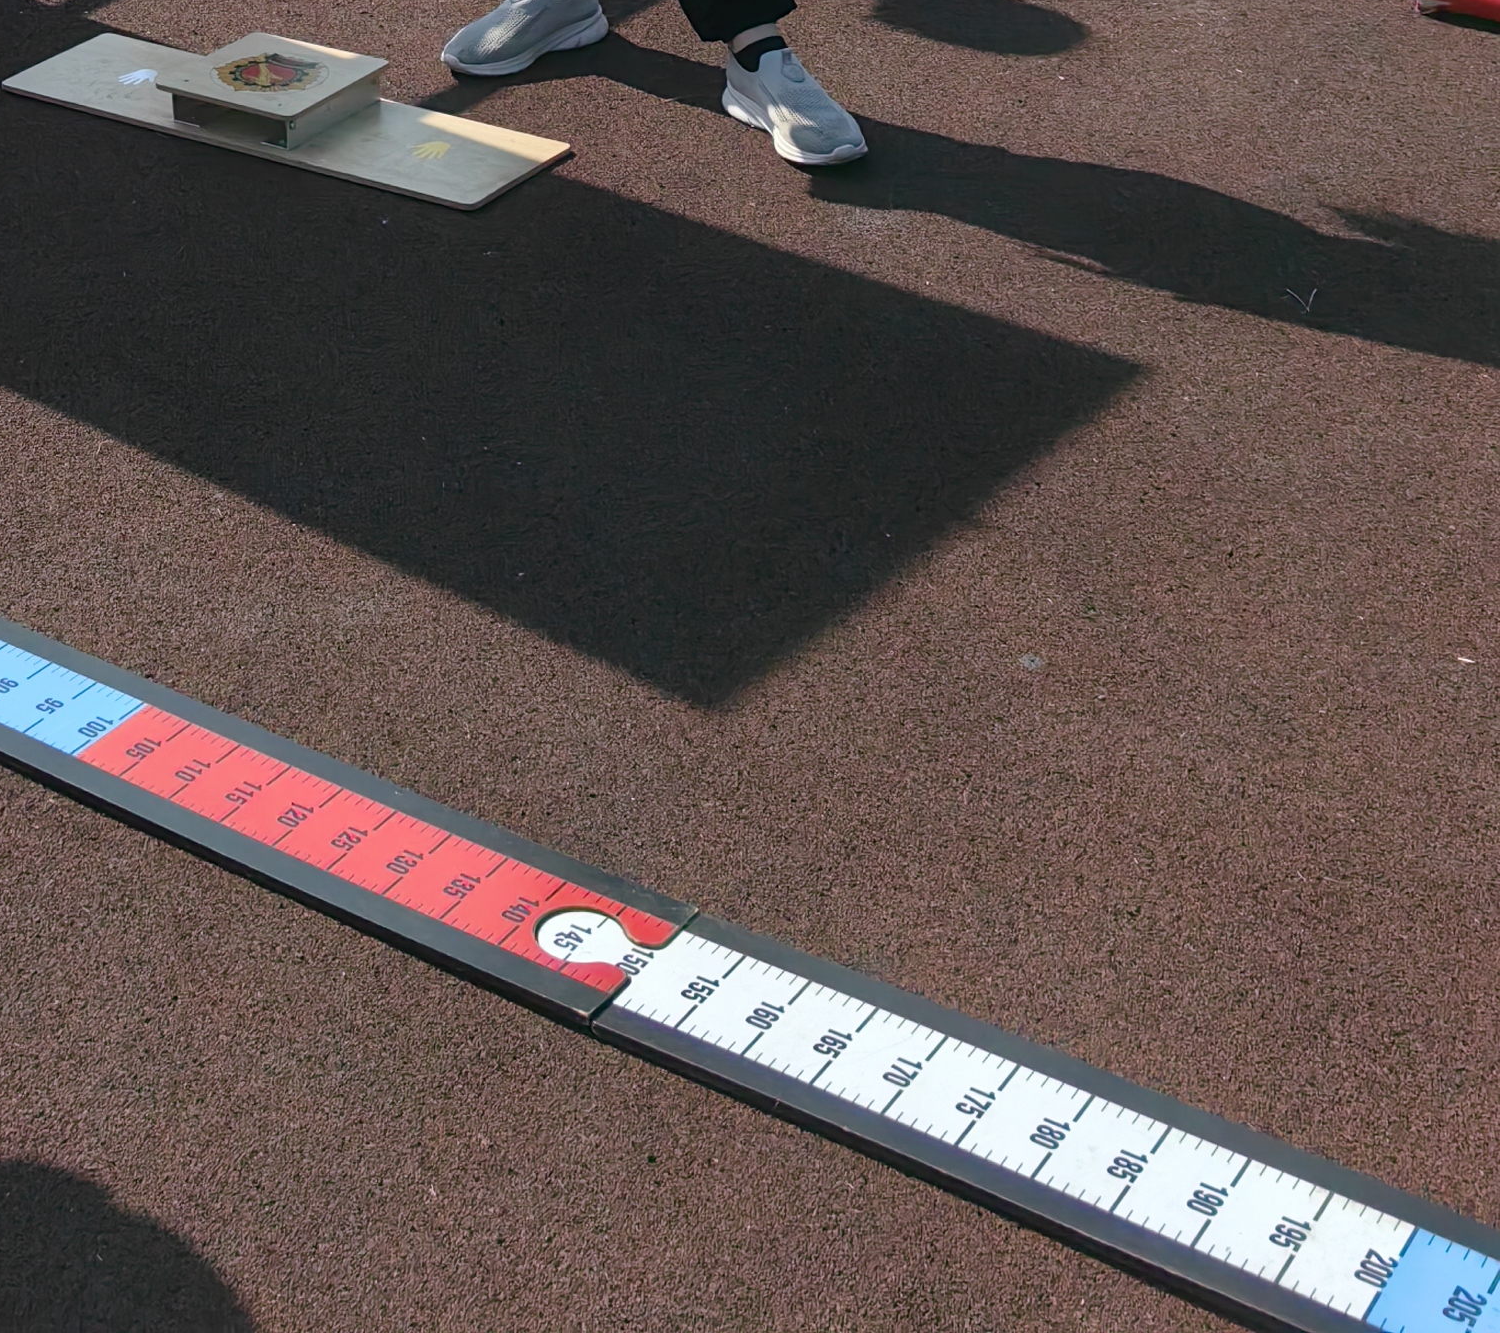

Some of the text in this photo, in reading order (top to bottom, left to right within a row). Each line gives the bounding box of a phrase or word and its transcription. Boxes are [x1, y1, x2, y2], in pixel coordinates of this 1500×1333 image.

[35, 697, 64, 714] 95
[77, 716, 115, 738] 100
[125, 737, 162, 760] 105
[174, 759, 211, 782] 110
[225, 781, 262, 805] 115
[276, 802, 314, 828] 120
[330, 826, 368, 851] 125
[386, 849, 424, 875] 130
[443, 873, 481, 899] 135
[501, 896, 540, 923] 140
[553, 924, 592, 952] 145
[615, 947, 654, 976] 150
[680, 975, 720, 1004] 155
[745, 1001, 785, 1030] 160
[812, 1028, 852, 1059] 165
[882, 1057, 923, 1088] 170
[955, 1087, 996, 1119] 175
[1029, 1117, 1071, 1150] 180
[1106, 1149, 1148, 1183] 185
[1186, 1182, 1229, 1217] 190
[1269, 1216, 1312, 1252] 195
[1354, 1248, 1399, 1289] 200
[1442, 1285, 1487, 1328] 205
